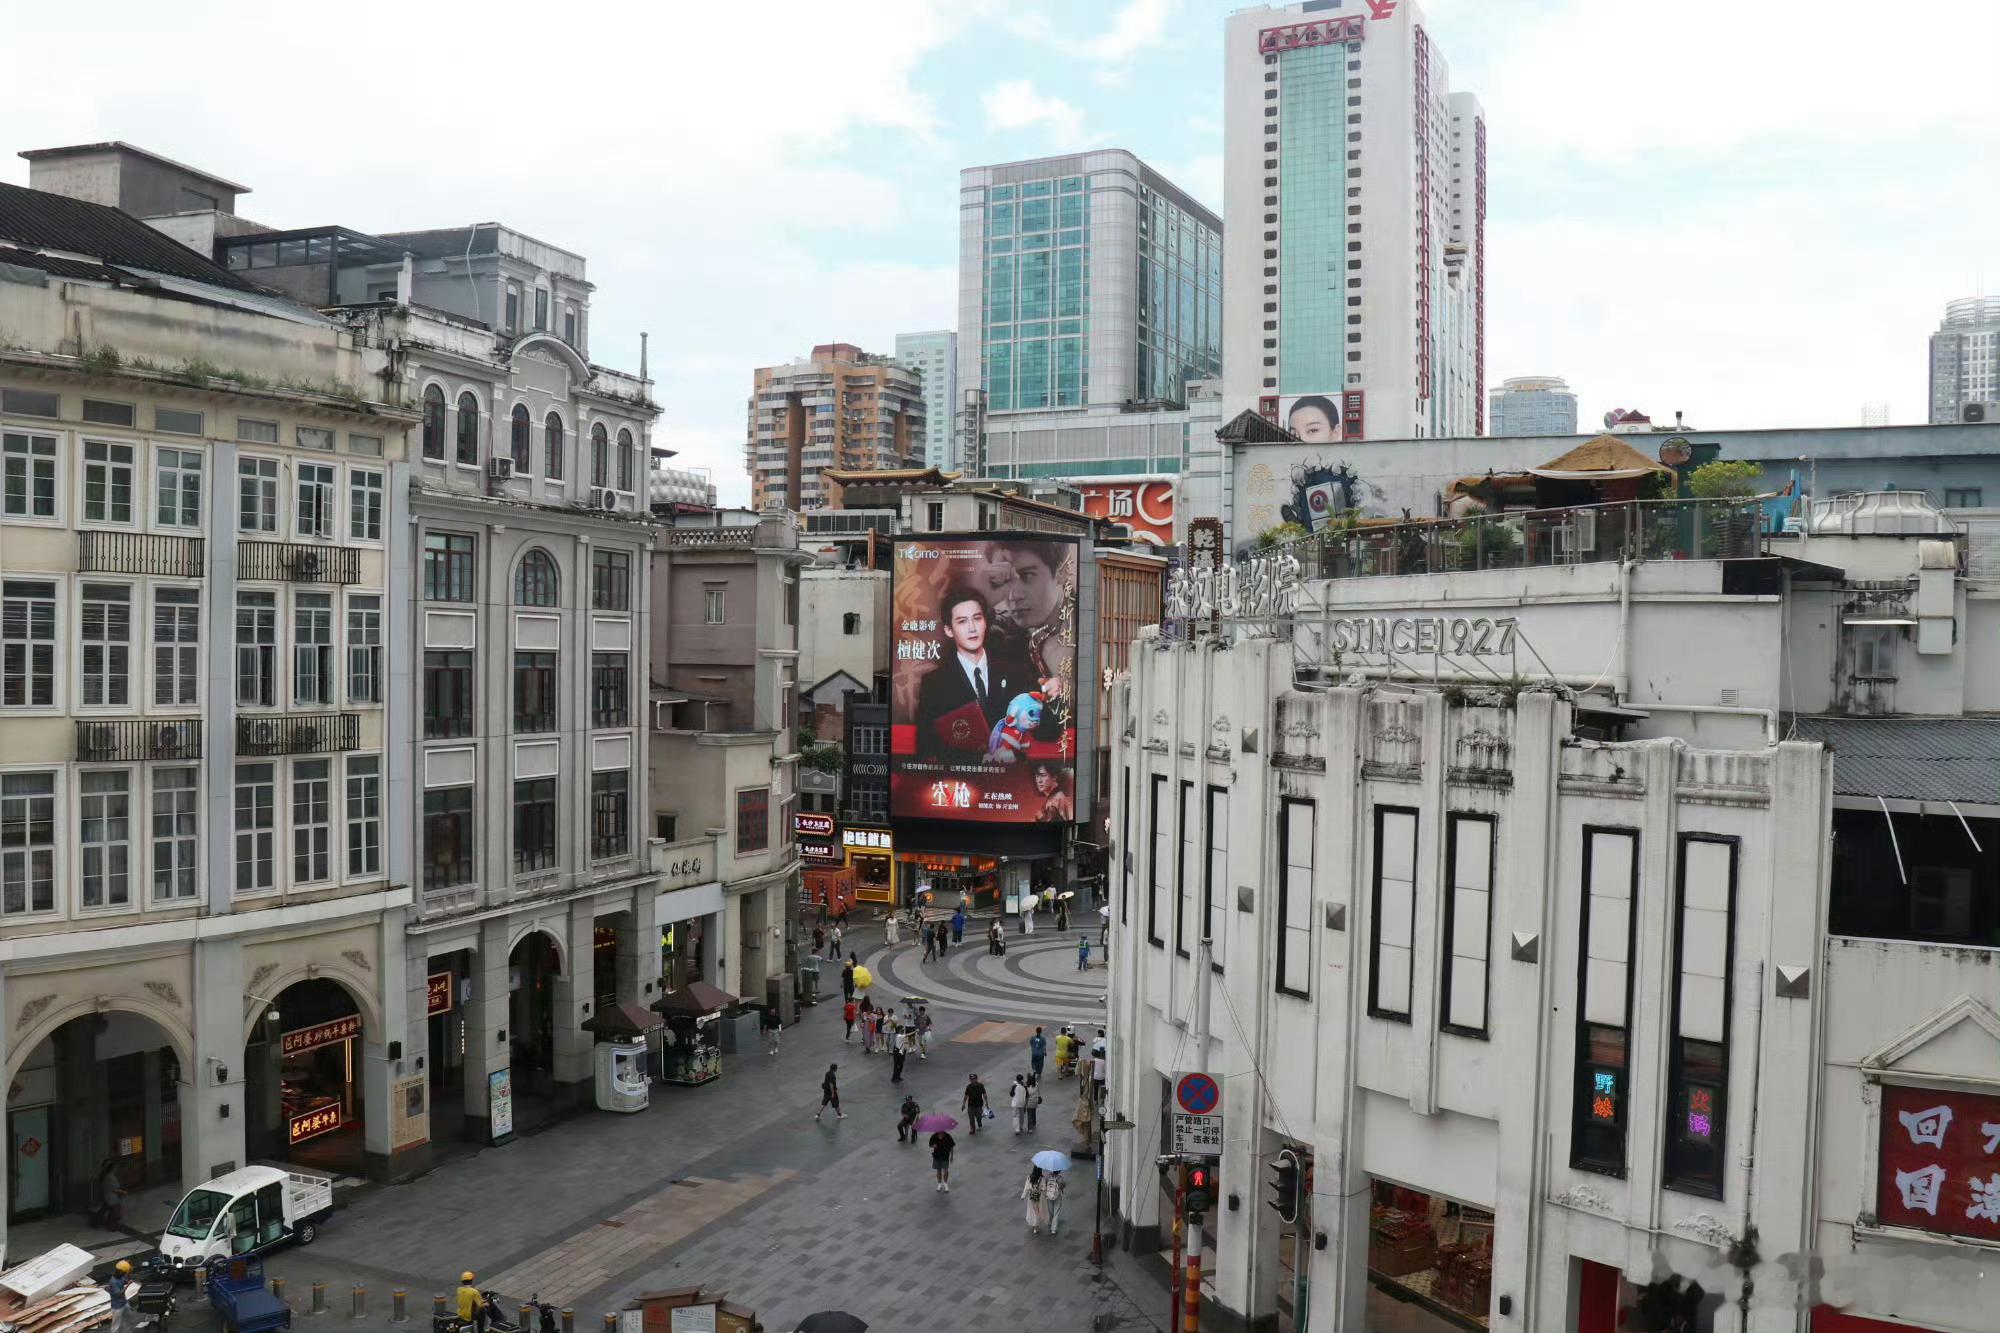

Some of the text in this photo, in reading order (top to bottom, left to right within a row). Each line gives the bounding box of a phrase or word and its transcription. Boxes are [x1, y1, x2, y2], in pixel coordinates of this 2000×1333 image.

[1080, 489, 1133, 517] 广场
[1165, 555, 1299, 619] 永汉电影院
[897, 640, 941, 660] 檀健次
[1333, 617, 1518, 657] SINCE1927
[932, 781, 970, 807] 空枪
[1176, 1124, 1220, 1135] 禁止一切停
